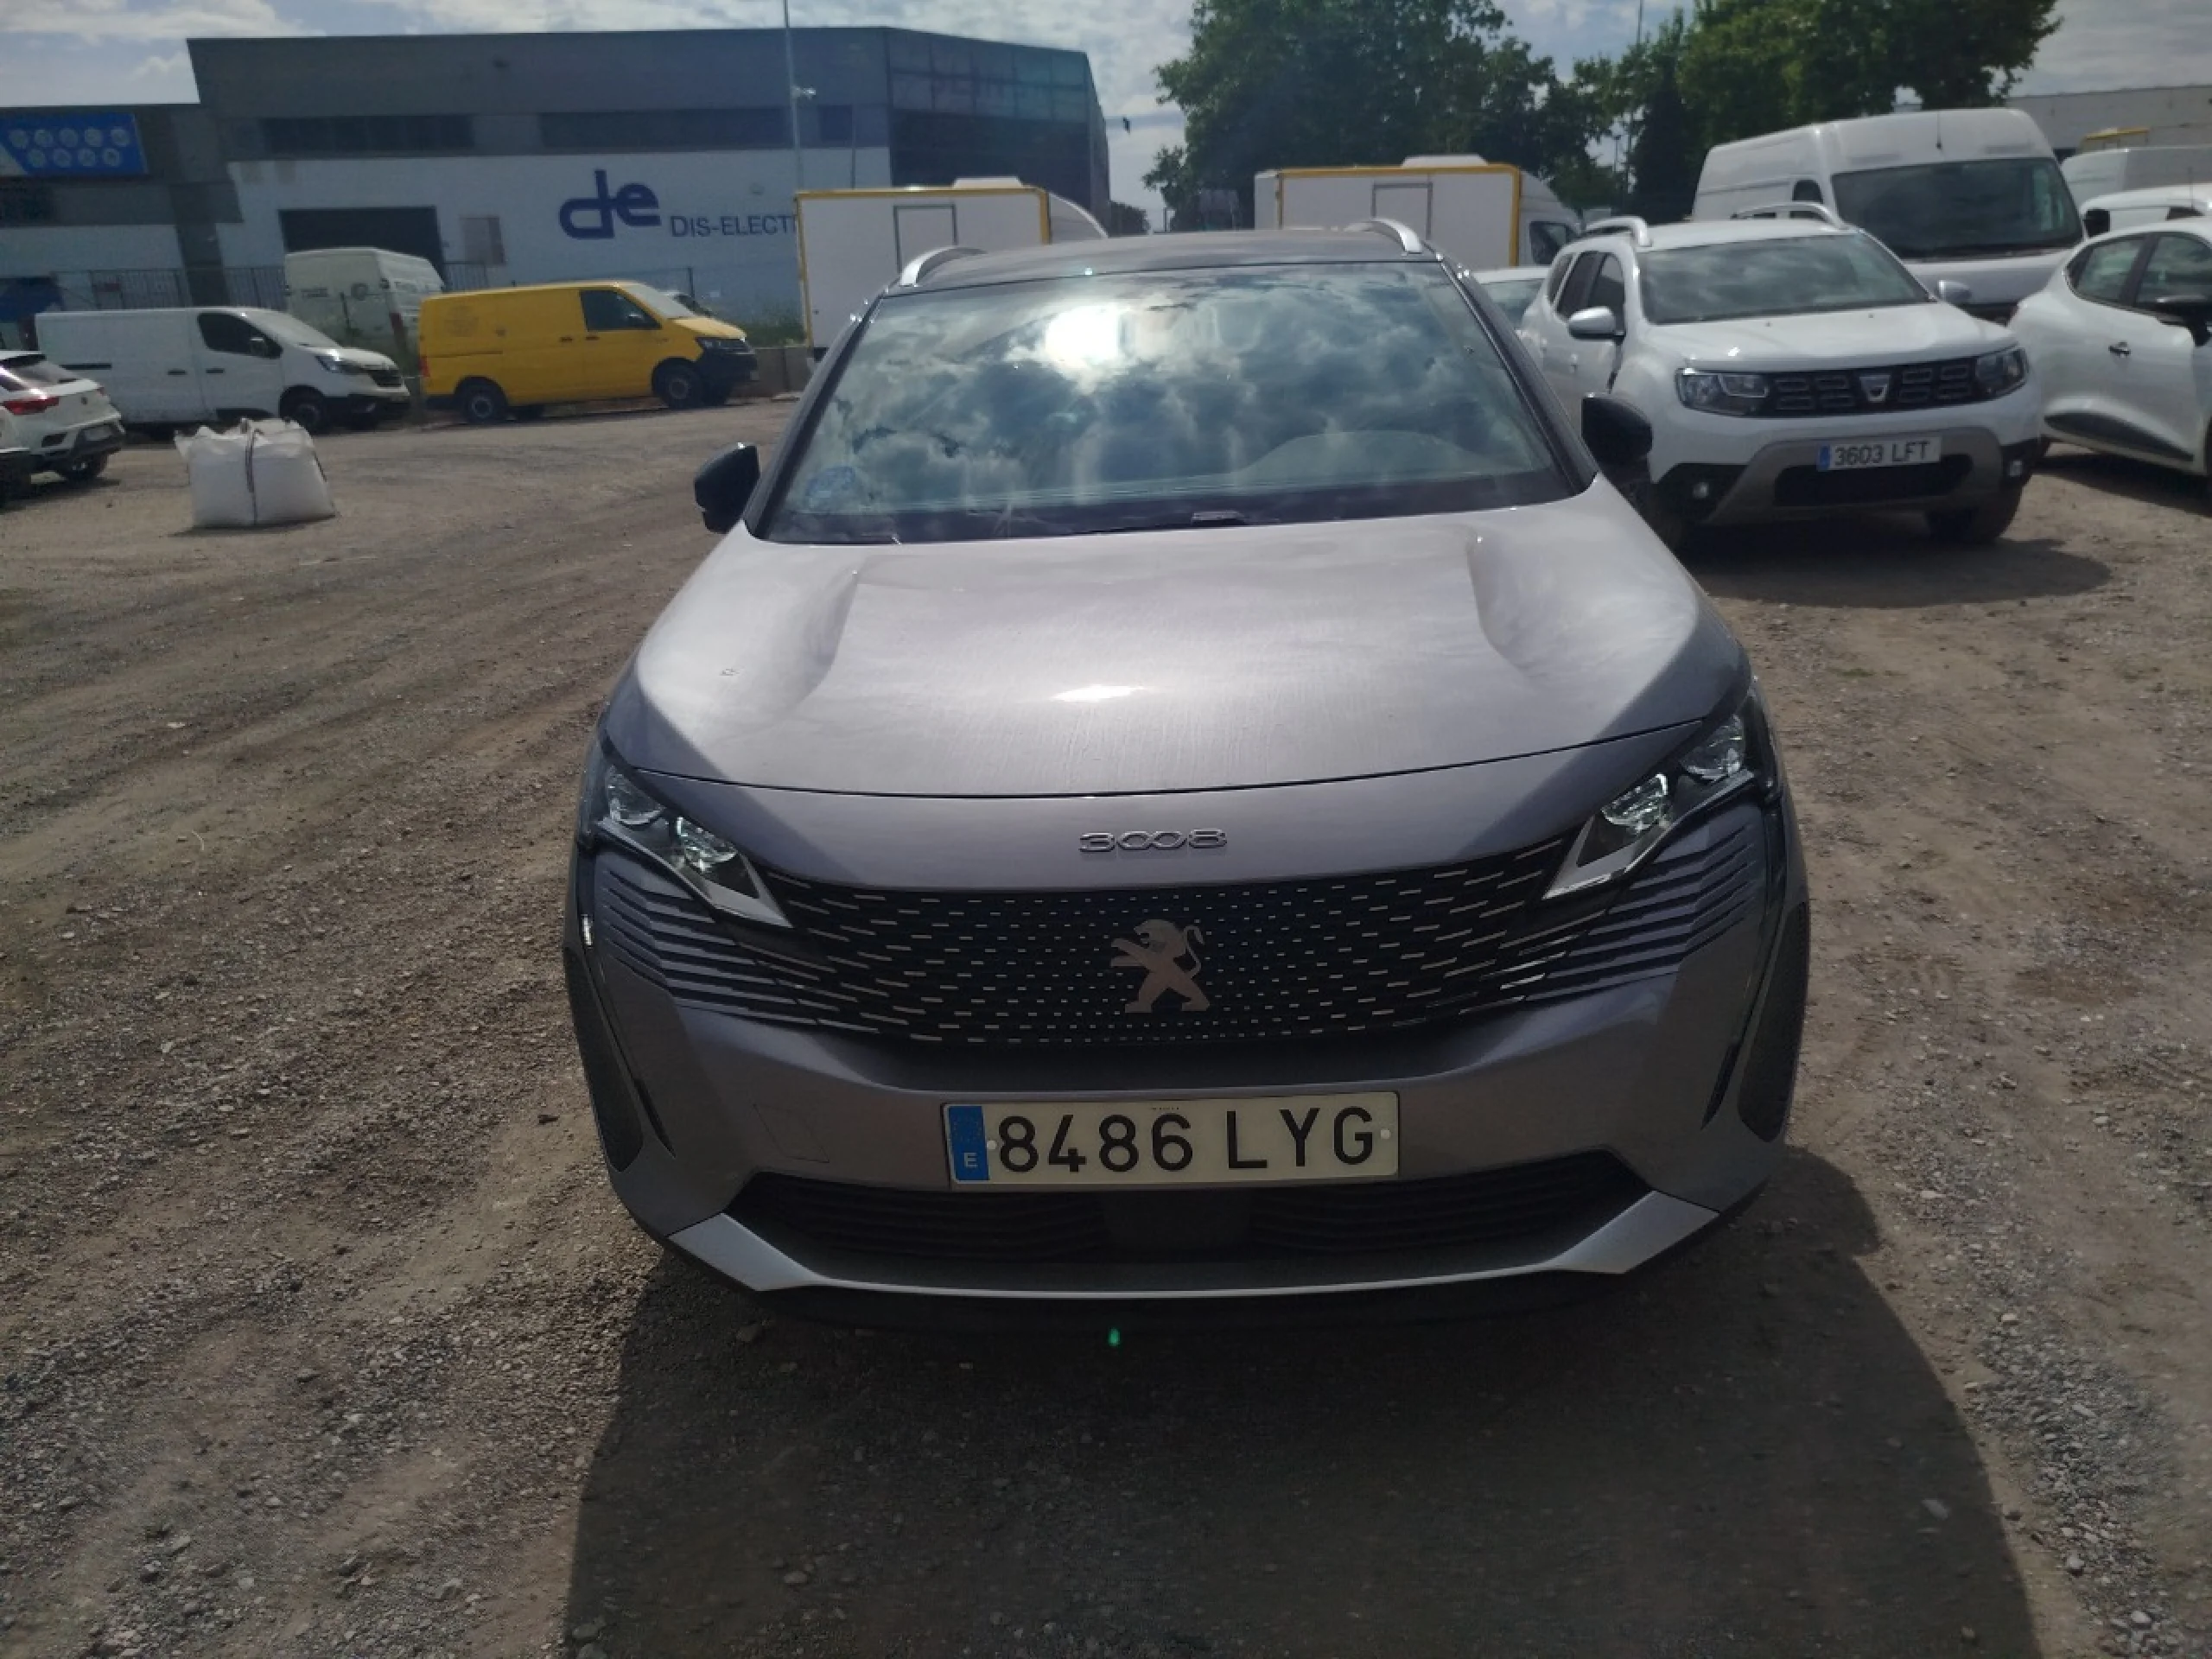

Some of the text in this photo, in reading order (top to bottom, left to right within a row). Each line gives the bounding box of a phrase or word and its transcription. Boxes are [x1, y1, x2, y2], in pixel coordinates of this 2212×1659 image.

[670, 214, 797, 238] DIS-ELECT
[1834, 441, 1930, 466] 3603 LFT
[1078, 828, 1227, 852] 3008
[998, 1106, 1373, 1173] 8486 LYG
[963, 1152, 978, 1168] E
